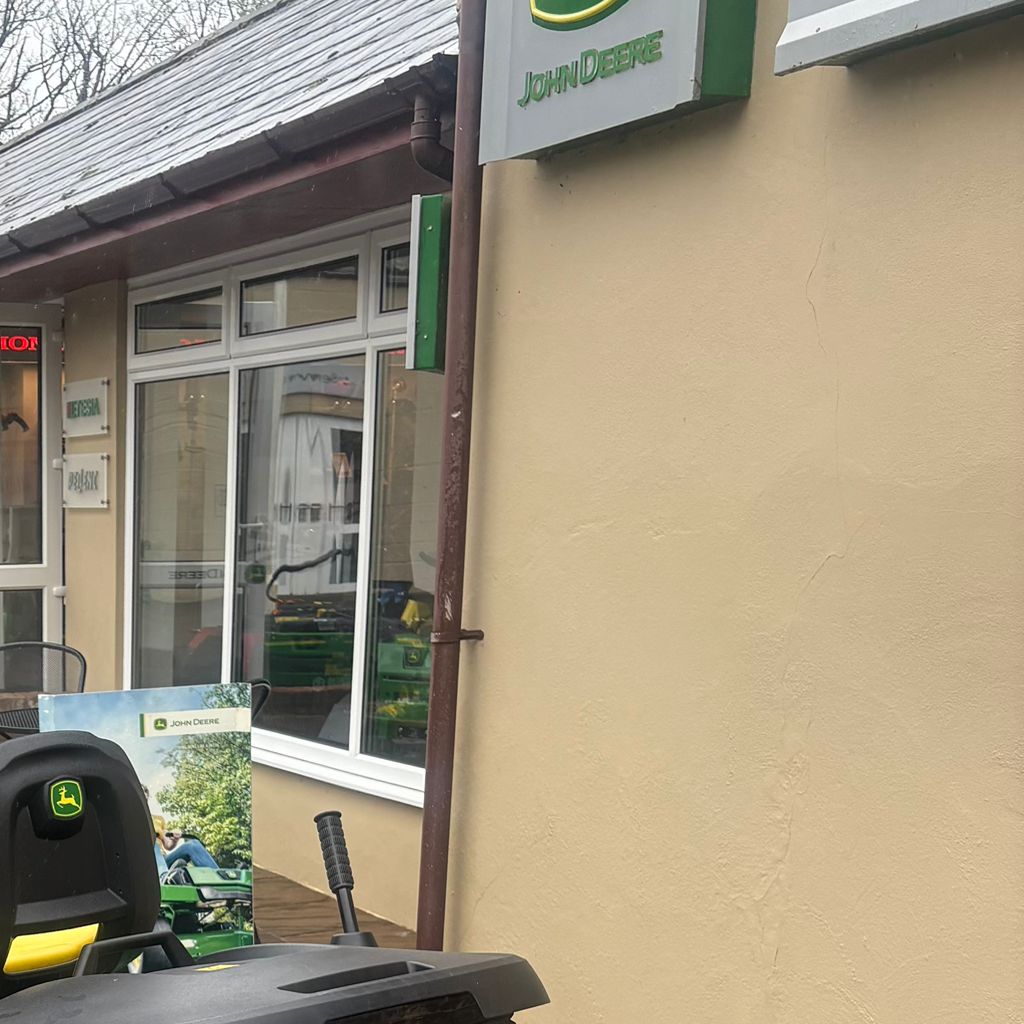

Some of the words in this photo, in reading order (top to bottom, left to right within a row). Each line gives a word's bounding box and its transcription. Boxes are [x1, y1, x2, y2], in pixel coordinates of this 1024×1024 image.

[517, 60, 578, 108] JOHN
[579, 29, 664, 85] DEERE
[170, 719, 192, 727] JOHN
[193, 718, 220, 726] DEERE
